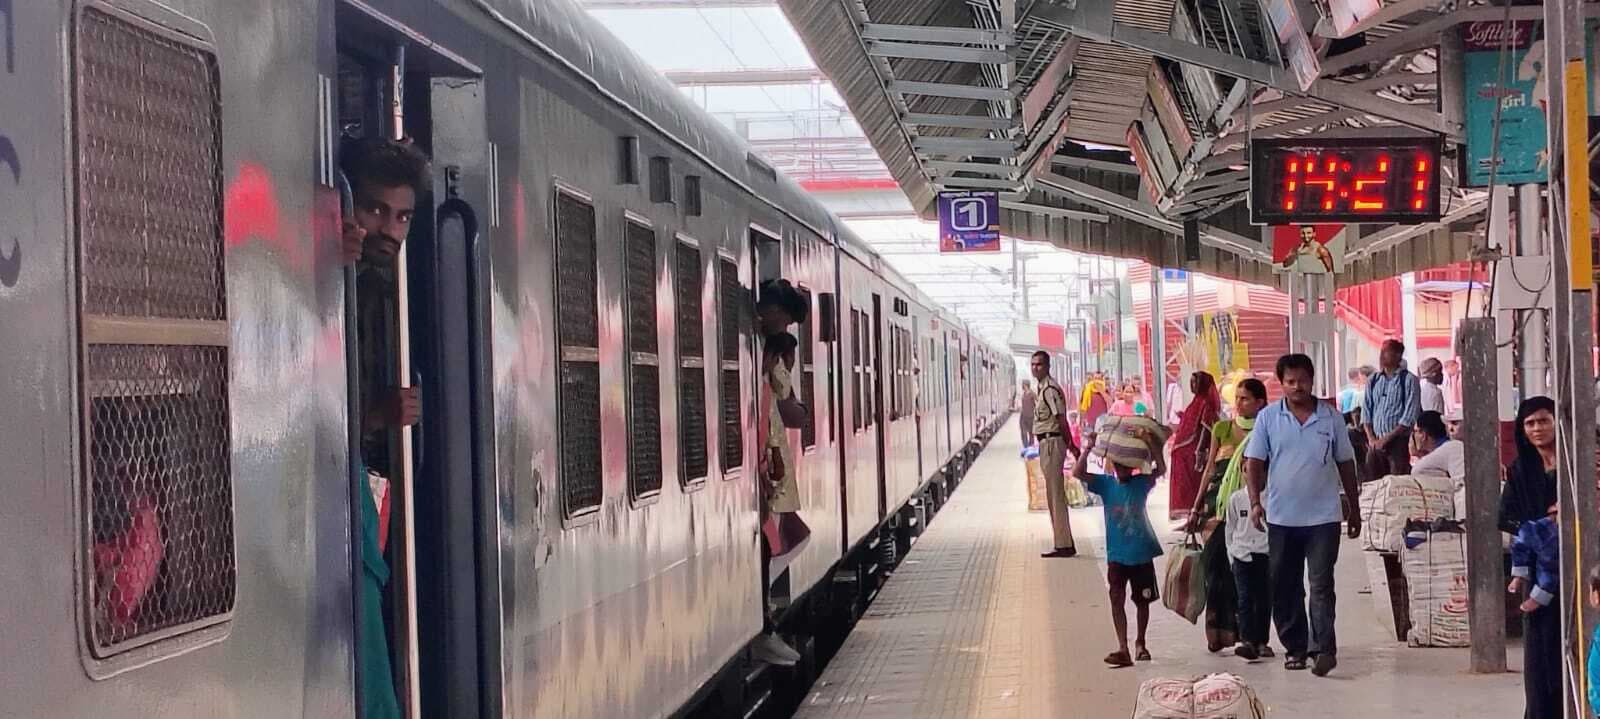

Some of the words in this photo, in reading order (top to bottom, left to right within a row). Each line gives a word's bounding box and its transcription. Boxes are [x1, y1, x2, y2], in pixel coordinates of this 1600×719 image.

[1501, 94, 1525, 111] girl
[1283, 157, 1428, 211] 14:21
[959, 202, 977, 227] 1
